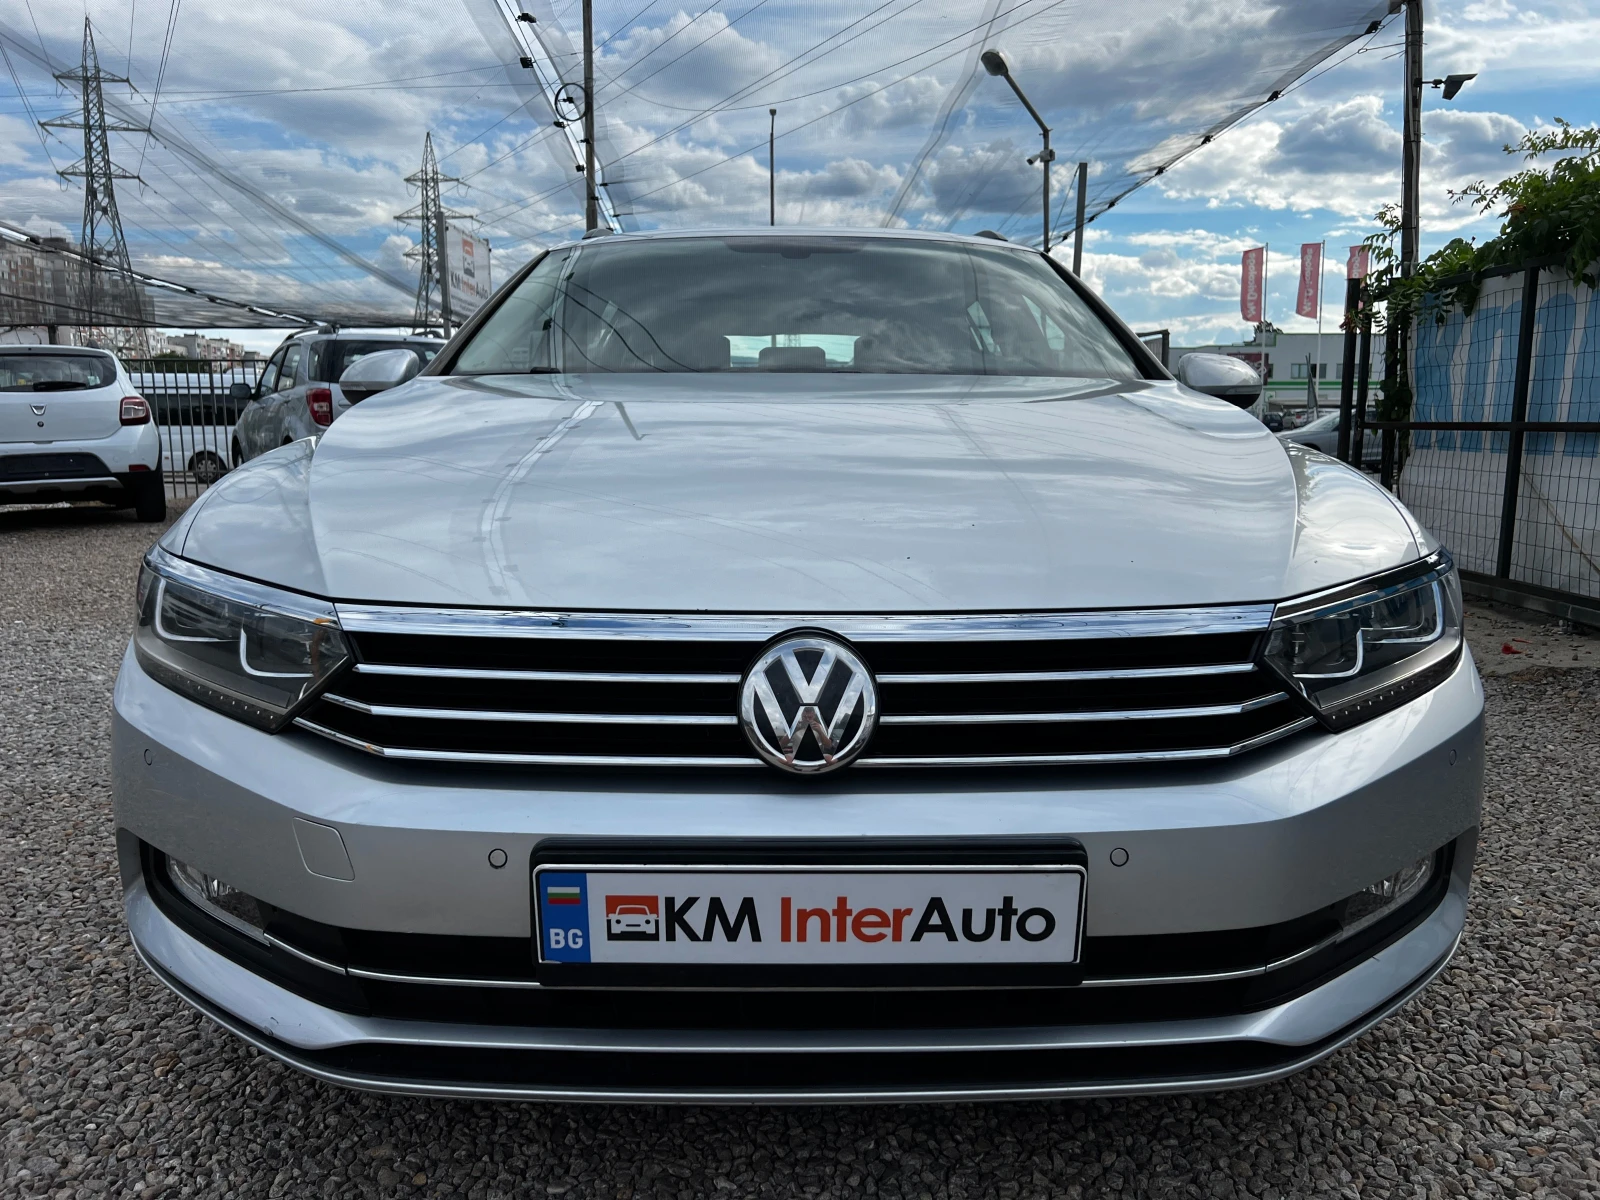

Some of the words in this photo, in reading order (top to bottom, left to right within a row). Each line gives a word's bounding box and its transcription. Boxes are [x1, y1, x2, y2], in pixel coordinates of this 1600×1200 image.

[665, 895, 763, 943] KM
[780, 895, 1057, 943] InterAuto
[549, 927, 584, 950] BG
